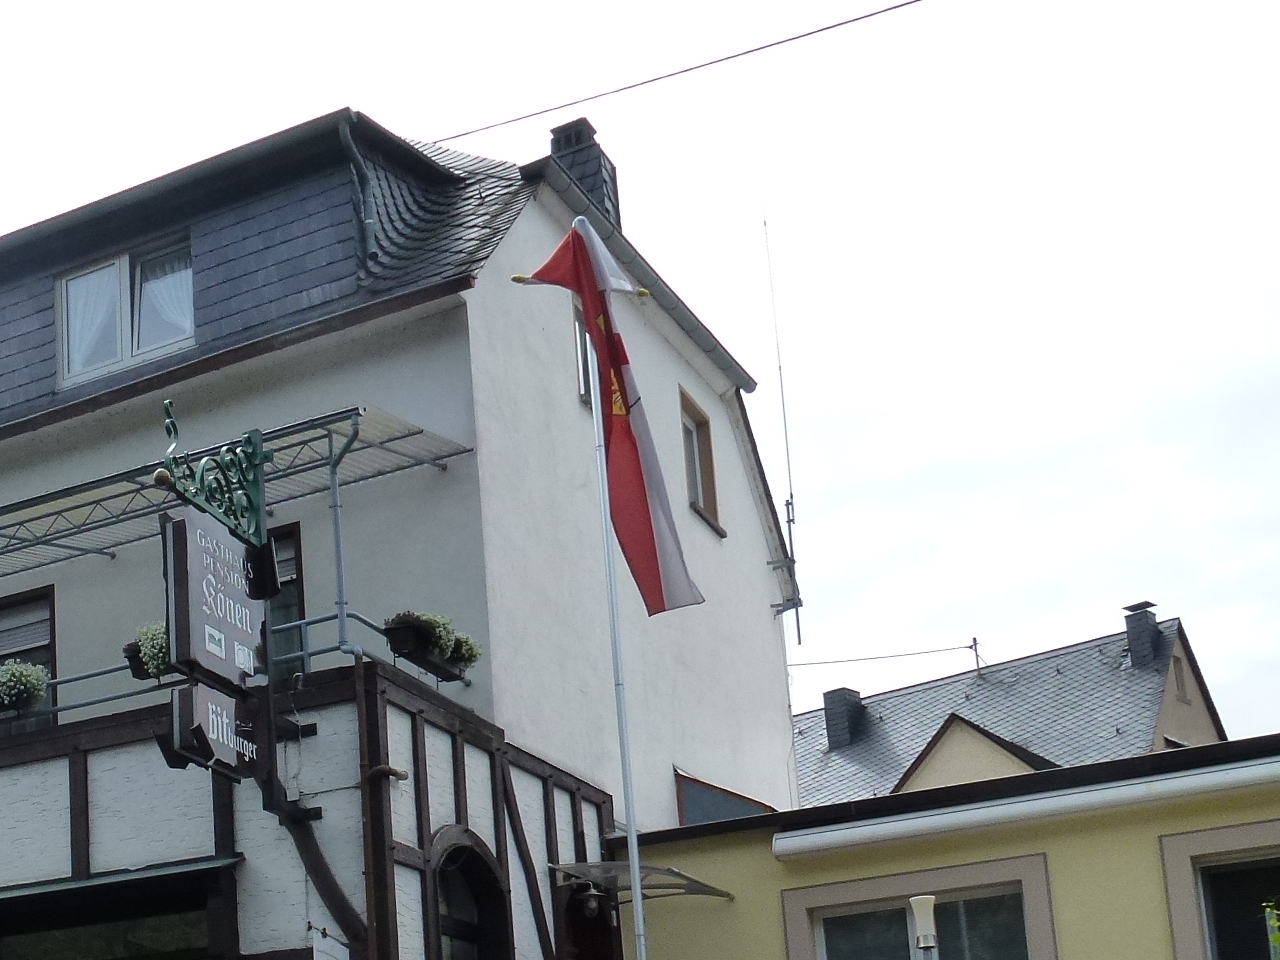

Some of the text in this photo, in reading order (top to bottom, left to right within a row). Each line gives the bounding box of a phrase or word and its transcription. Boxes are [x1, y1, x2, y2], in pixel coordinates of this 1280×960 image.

[196, 528, 254, 579] GASTHAUS
[203, 552, 250, 595] PENSION
[202, 573, 253, 634] Könen
[208, 701, 258, 762] Bitburger
